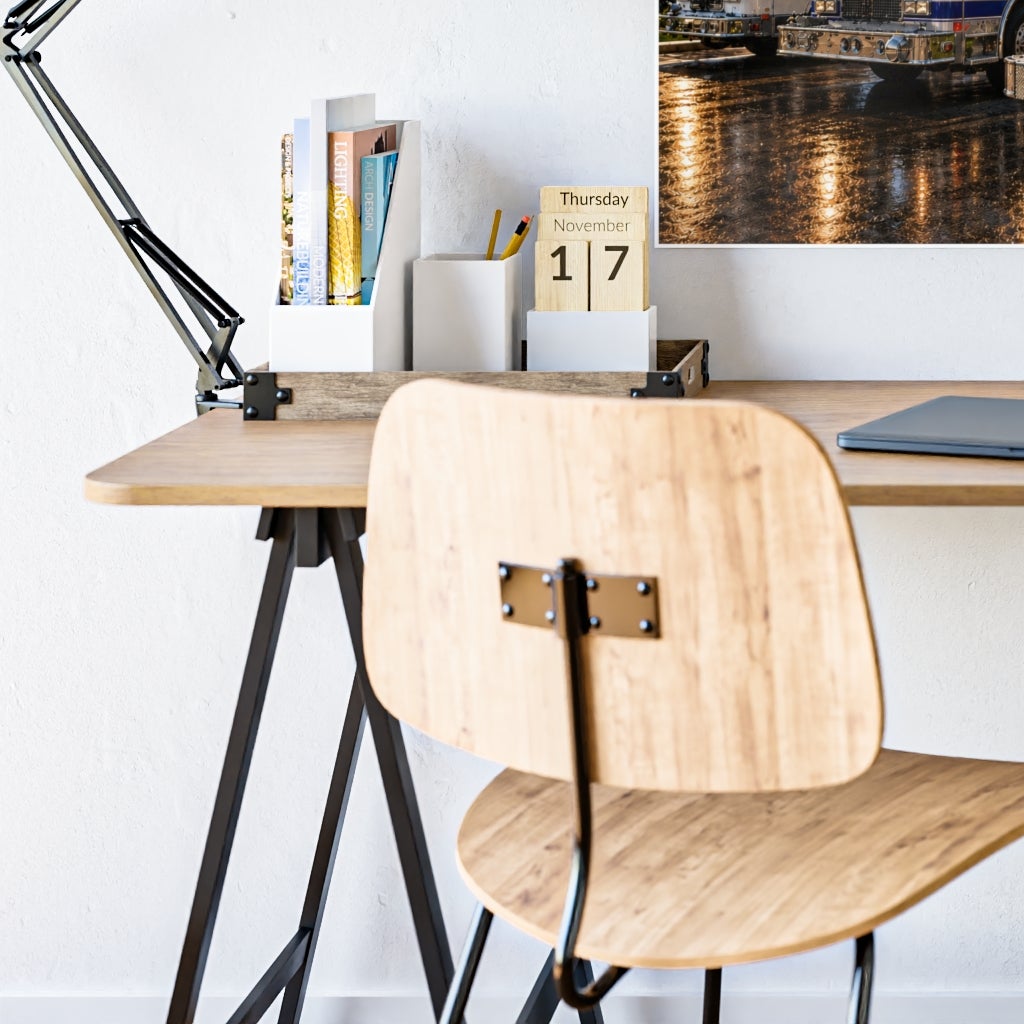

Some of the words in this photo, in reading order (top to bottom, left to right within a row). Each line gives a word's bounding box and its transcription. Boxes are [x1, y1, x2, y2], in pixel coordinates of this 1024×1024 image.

[334, 141, 348, 219] LIGHTING
[364, 161, 374, 189] ARCH
[364, 192, 374, 231] DESIGN
[560, 192, 629, 208] Thursday
[554, 219, 630, 232] November
[314, 244, 326, 304] MODERN
[550, 245, 572, 280] 1
[604, 245, 629, 280] 7
